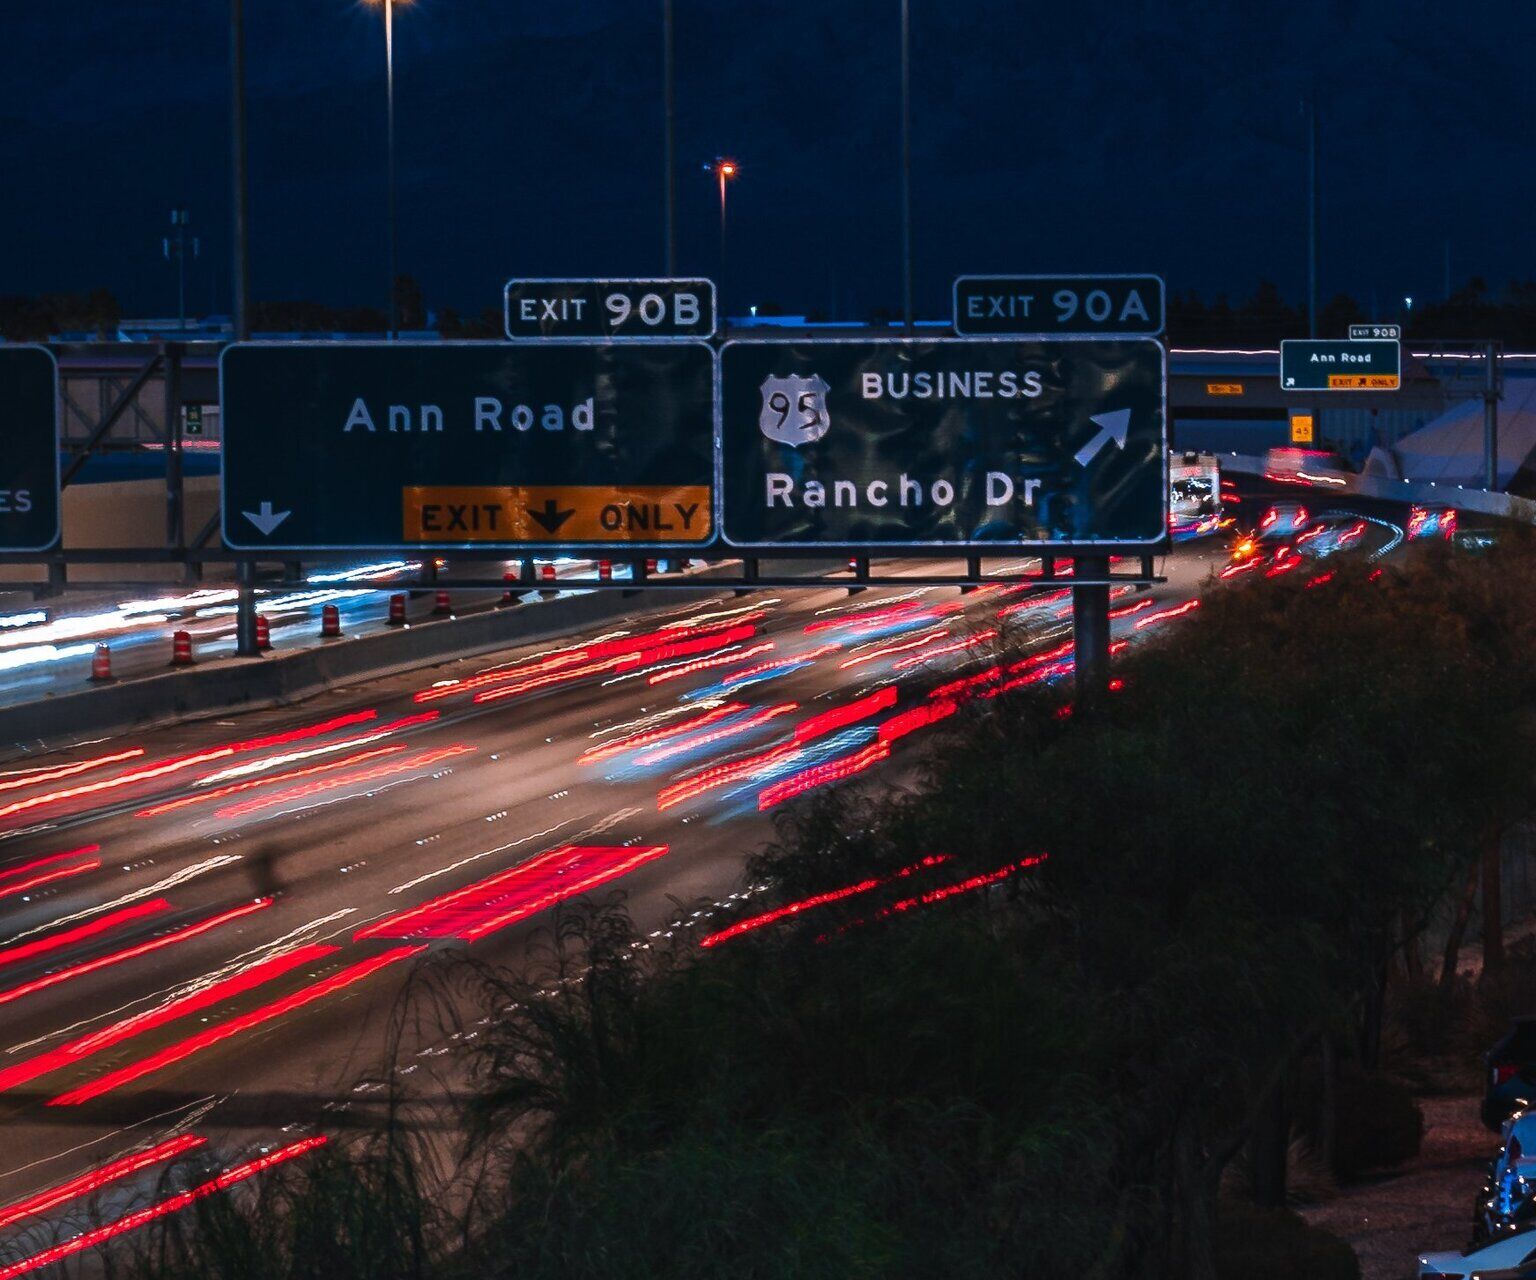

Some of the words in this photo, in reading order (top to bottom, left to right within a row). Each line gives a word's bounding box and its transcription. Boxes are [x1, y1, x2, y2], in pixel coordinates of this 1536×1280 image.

[520, 298, 587, 321] EXIT
[604, 292, 702, 327] 90B
[967, 296, 1034, 318] EXIT
[1053, 290, 1150, 321] 90A
[1310, 353, 1336, 363] Ann
[1341, 353, 1371, 362] Road
[862, 371, 1043, 400] BUSINESS
[344, 398, 444, 433] Ann
[474, 396, 595, 432] Road
[768, 392, 822, 430] 95
[766, 472, 954, 508] Rancho
[986, 471, 1042, 507] Dr
[421, 504, 501, 532] EXIT
[600, 503, 698, 531] ONLY
